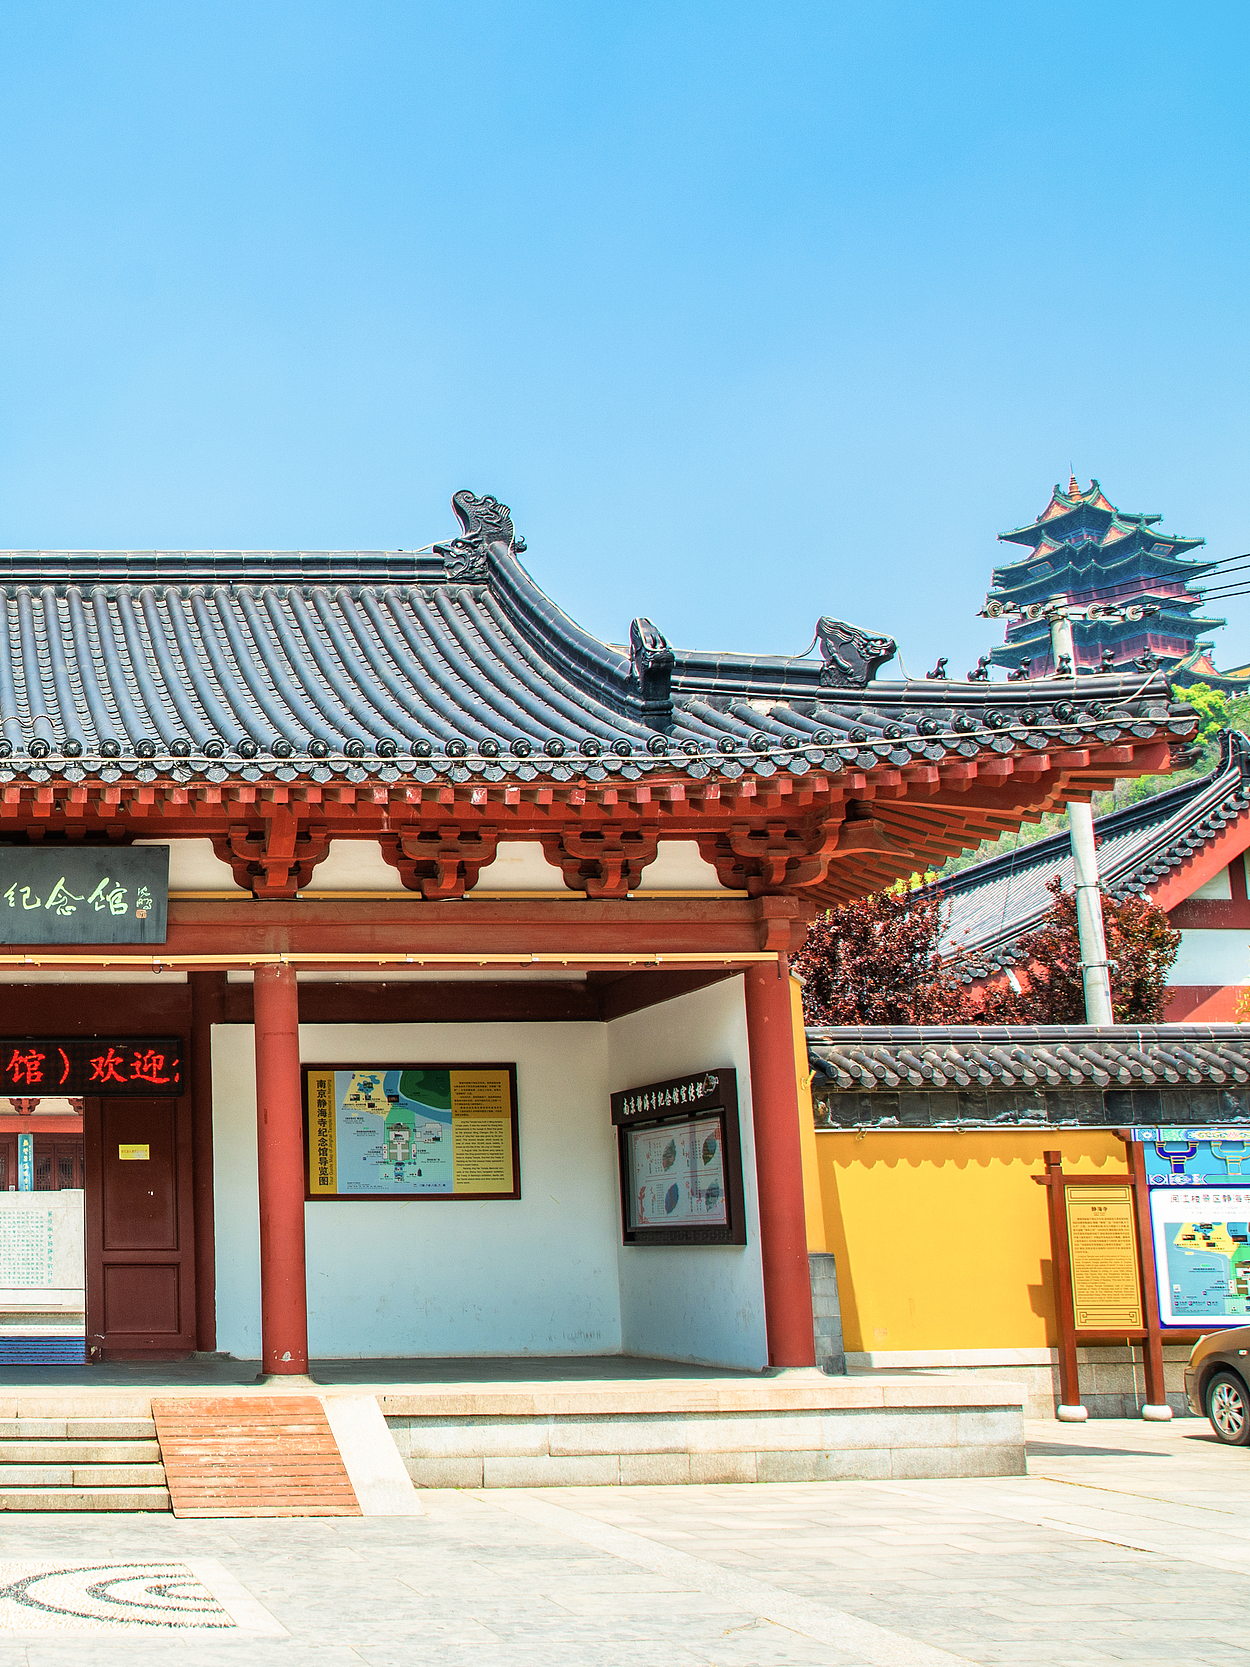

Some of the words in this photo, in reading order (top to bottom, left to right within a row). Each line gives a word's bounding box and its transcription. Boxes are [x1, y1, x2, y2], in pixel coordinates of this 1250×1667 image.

[316, 1079, 329, 1186] 南京静海寺纪念馆导览图
